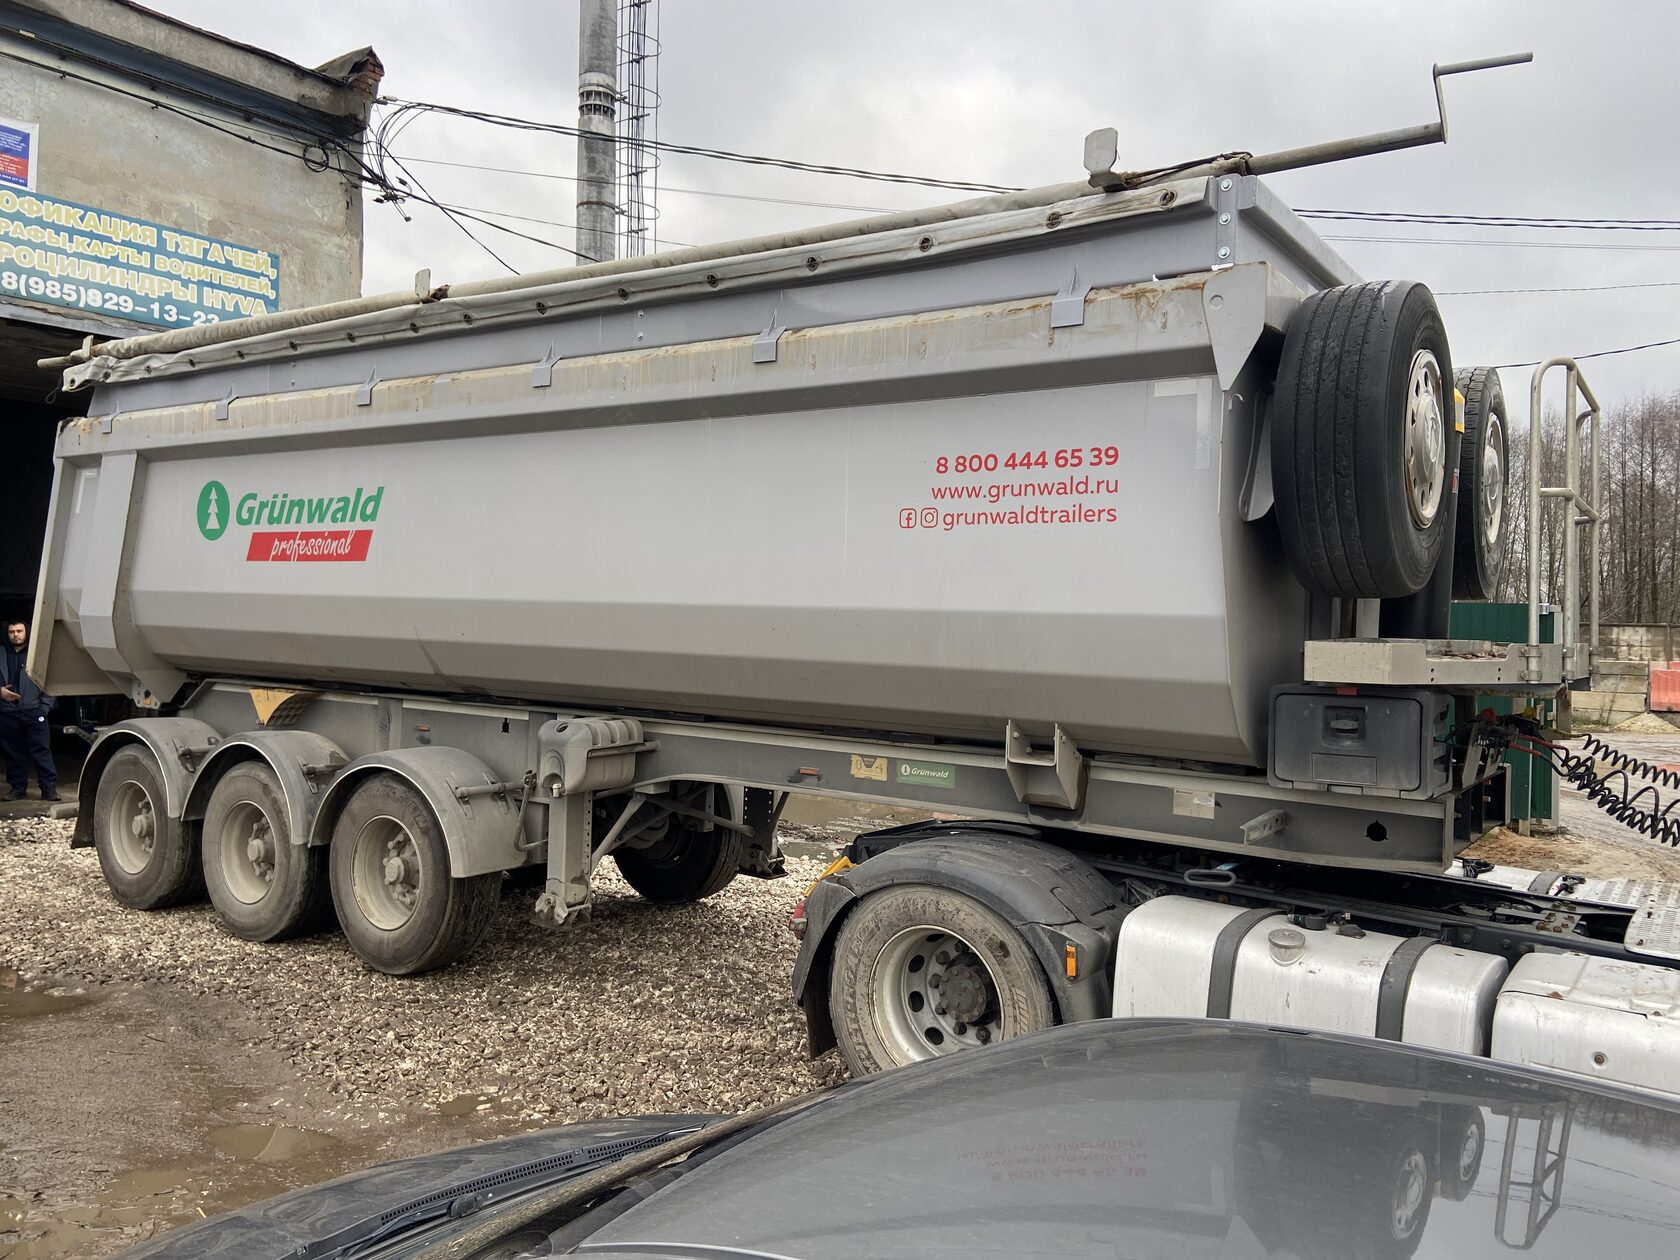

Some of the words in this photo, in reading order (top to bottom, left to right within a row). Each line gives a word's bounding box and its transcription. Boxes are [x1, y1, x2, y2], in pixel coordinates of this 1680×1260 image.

[162, 230, 277, 279] ТЯГАЧЕЙ,
[154, 254, 276, 299] ВОДИТЕЛЕЙ,
[203, 287, 267, 317] HYVA
[936, 456, 949, 474] 8
[954, 453, 999, 474] 800
[1004, 450, 1049, 470] 444
[1054, 448, 1083, 468] 65
[1089, 446, 1119, 466] 39
[931, 475, 1119, 503] www.grunwald.ru
[235, 486, 385, 526] Grünwald
[942, 503, 1117, 531] grunwaldtrailers
[269, 530, 356, 562] professional
[911, 767, 949, 778] Grünwald
